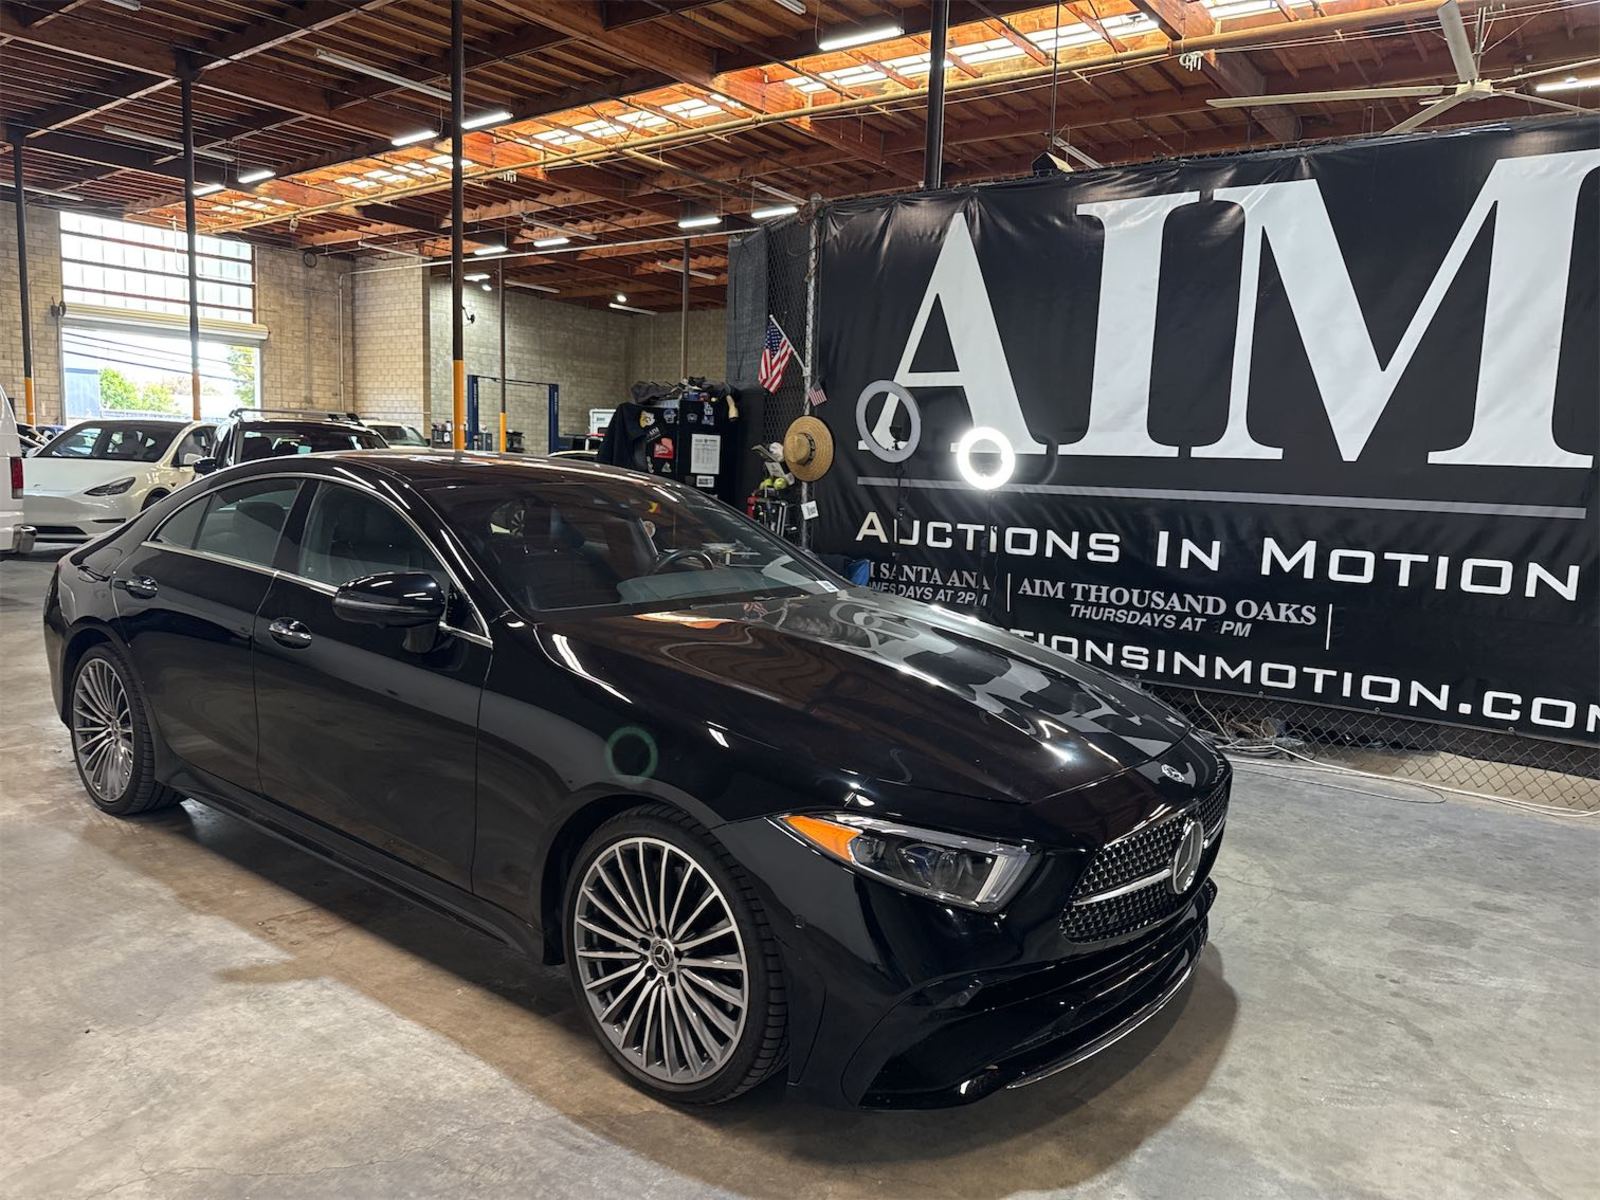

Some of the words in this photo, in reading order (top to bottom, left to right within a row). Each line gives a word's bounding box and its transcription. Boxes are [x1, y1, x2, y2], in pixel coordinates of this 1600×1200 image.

[857, 148, 1600, 468] AIM
[855, 511, 1121, 563] AUCTIONS
[1156, 530, 1221, 572] IN
[1260, 537, 1580, 601] MOTION
[935, 588, 955, 602] AT
[1018, 577, 1066, 601] AIM
[1071, 582, 1227, 616] THOUSAND
[1235, 599, 1317, 626] OAKS
[1069, 604, 1176, 629] THURSDAYS
[1179, 616, 1206, 633] AT
[1212, 619, 1252, 638] PM
